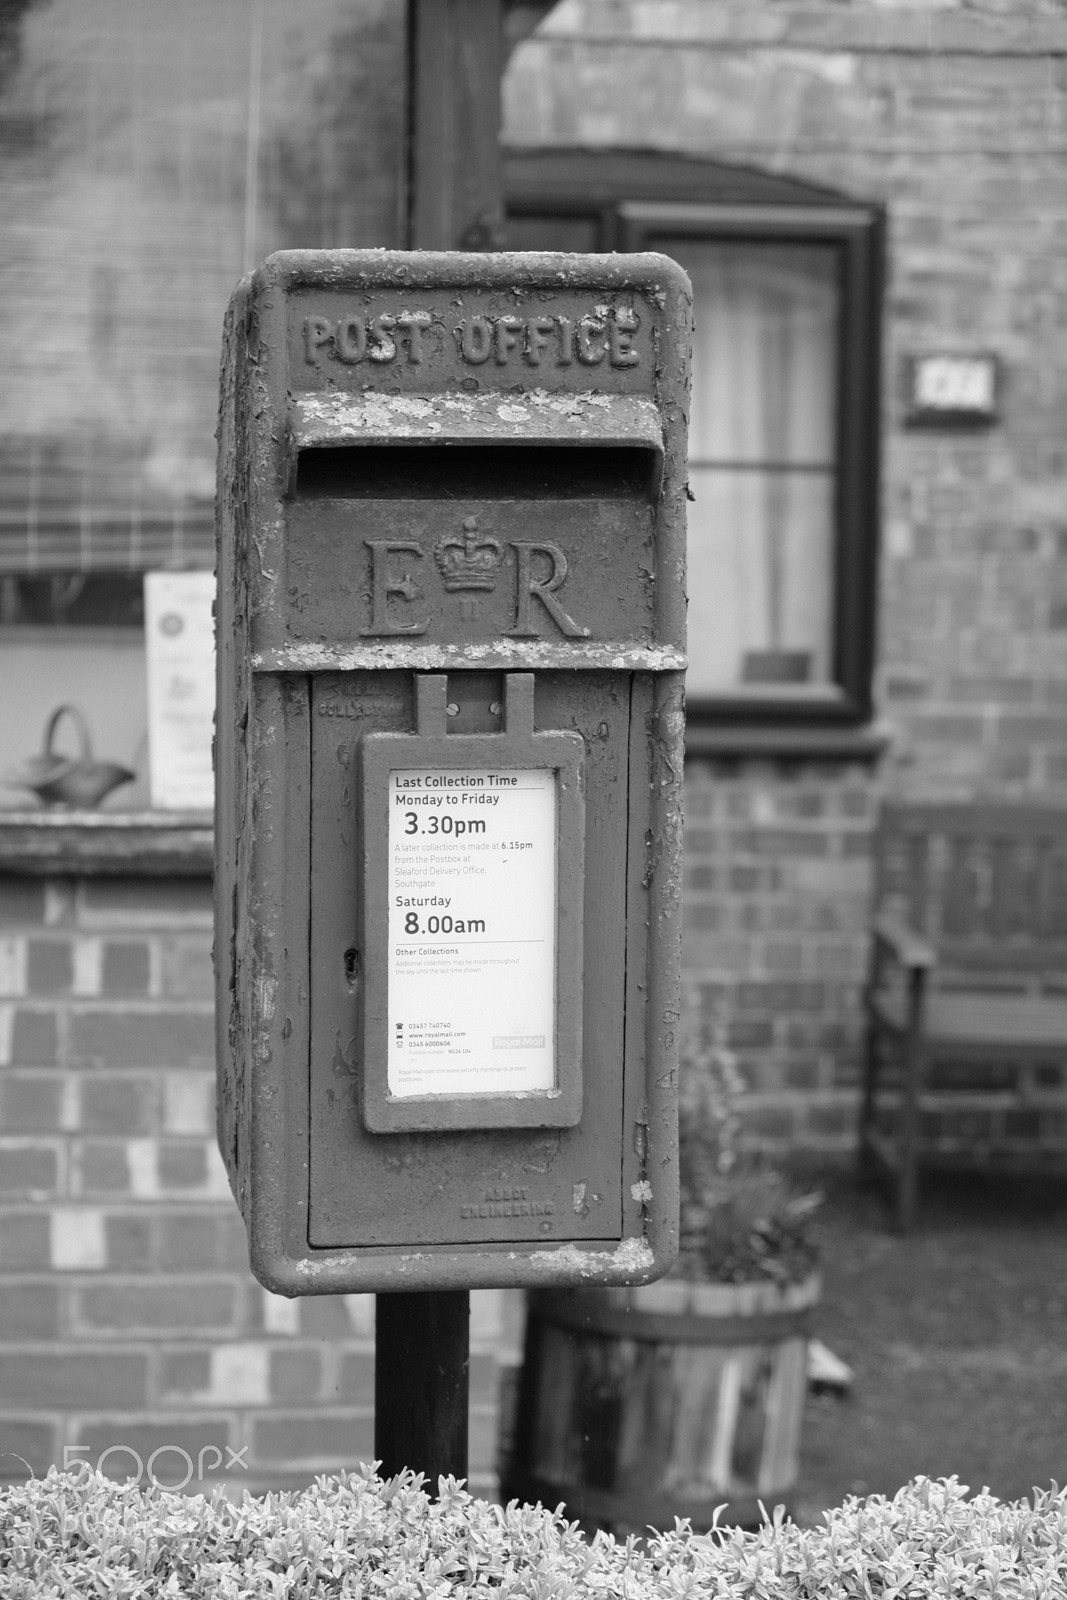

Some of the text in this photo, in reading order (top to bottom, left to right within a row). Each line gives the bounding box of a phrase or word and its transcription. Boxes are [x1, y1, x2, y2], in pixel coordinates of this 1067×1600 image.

[303, 309, 640, 369] POST OFFICE
[359, 539, 592, 639] E R
[395, 774, 518, 788] Last Collection Time
[395, 793, 500, 807] Monday to Friday
[404, 812, 486, 838] 3.30pm
[402, 844, 420, 852] later
[422, 843, 458, 851] collection
[468, 842, 490, 850] made
[501, 842, 533, 850] 6.15pm
[394, 856, 414, 864] from
[415, 855, 428, 863] the
[430, 854, 461, 863] Postbox
[394, 867, 428, 876] Sleaford
[430, 866, 461, 876] Delivery
[394, 880, 436, 889] Southgate
[395, 895, 452, 908] Saturday
[404, 912, 486, 934] 8.00am
[395, 947, 459, 956] Other Collections
[495, 1037, 543, 1048] Royal Mail
